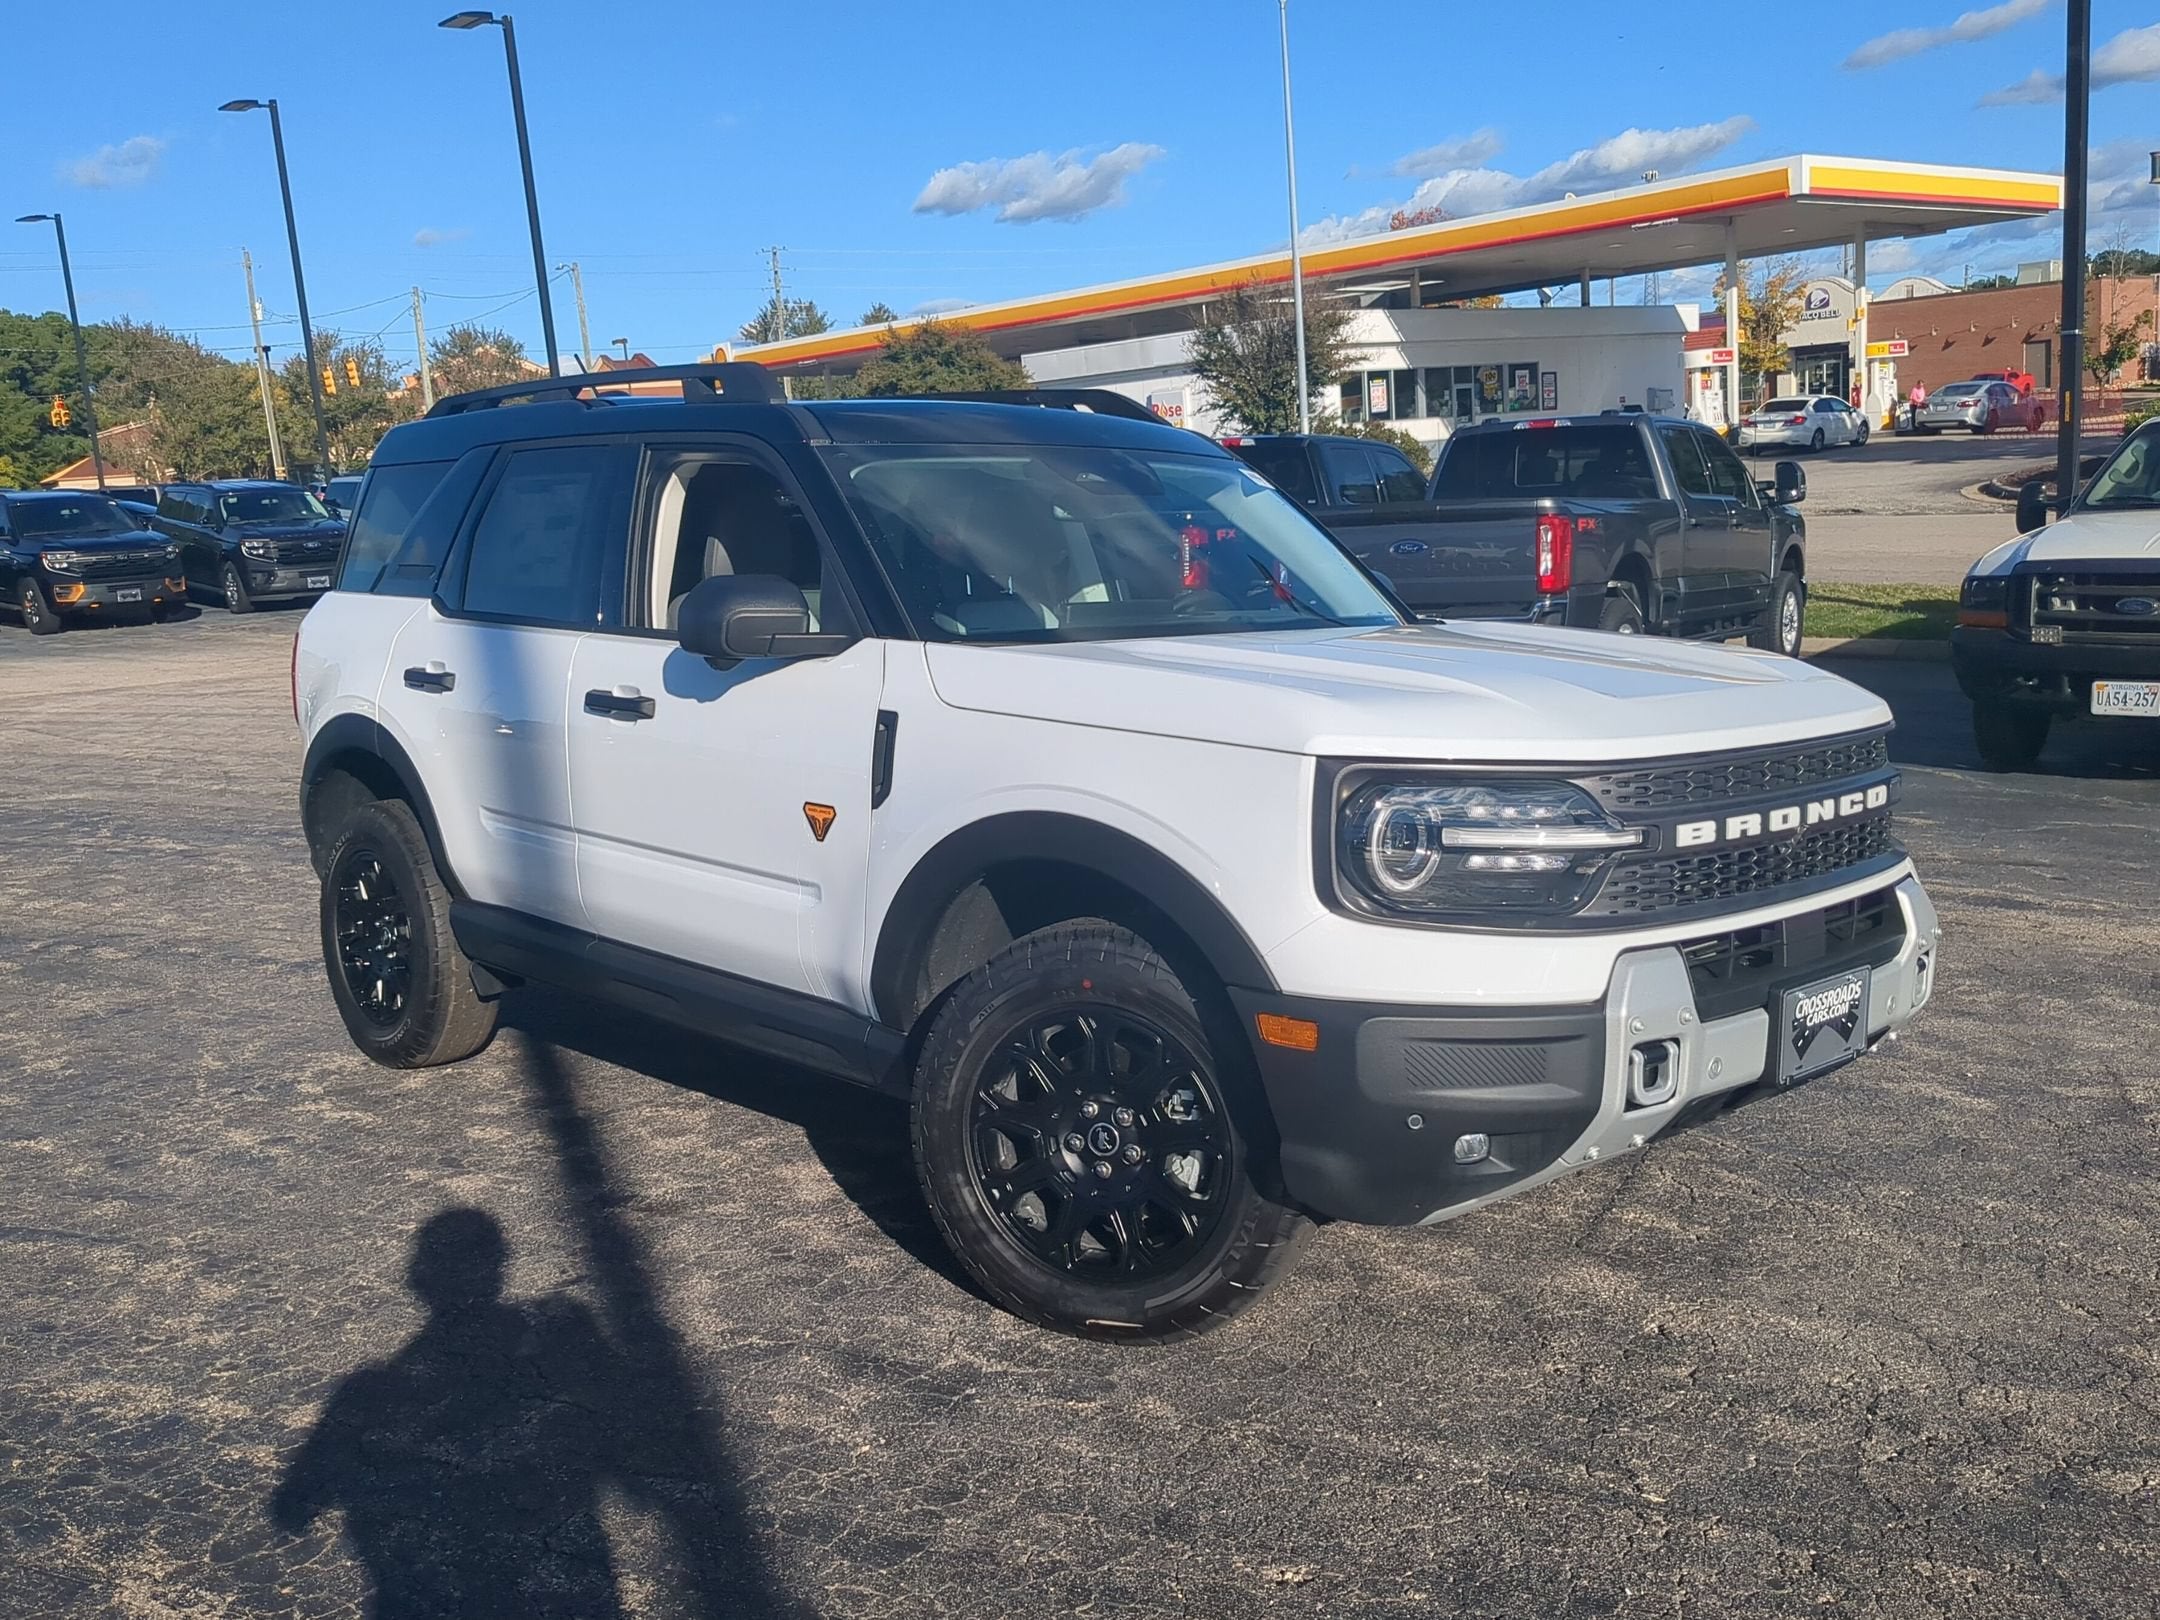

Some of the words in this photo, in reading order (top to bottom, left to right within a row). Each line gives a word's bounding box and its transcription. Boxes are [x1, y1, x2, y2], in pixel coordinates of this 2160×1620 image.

[1820, 309, 1841, 319] BELL
[2097, 691, 2158, 707] UA54-257
[1676, 785, 1887, 847] BRONCO
[1795, 980, 1863, 1019] CROSSROADS
[1806, 1001, 1850, 1027] CARS.COM
